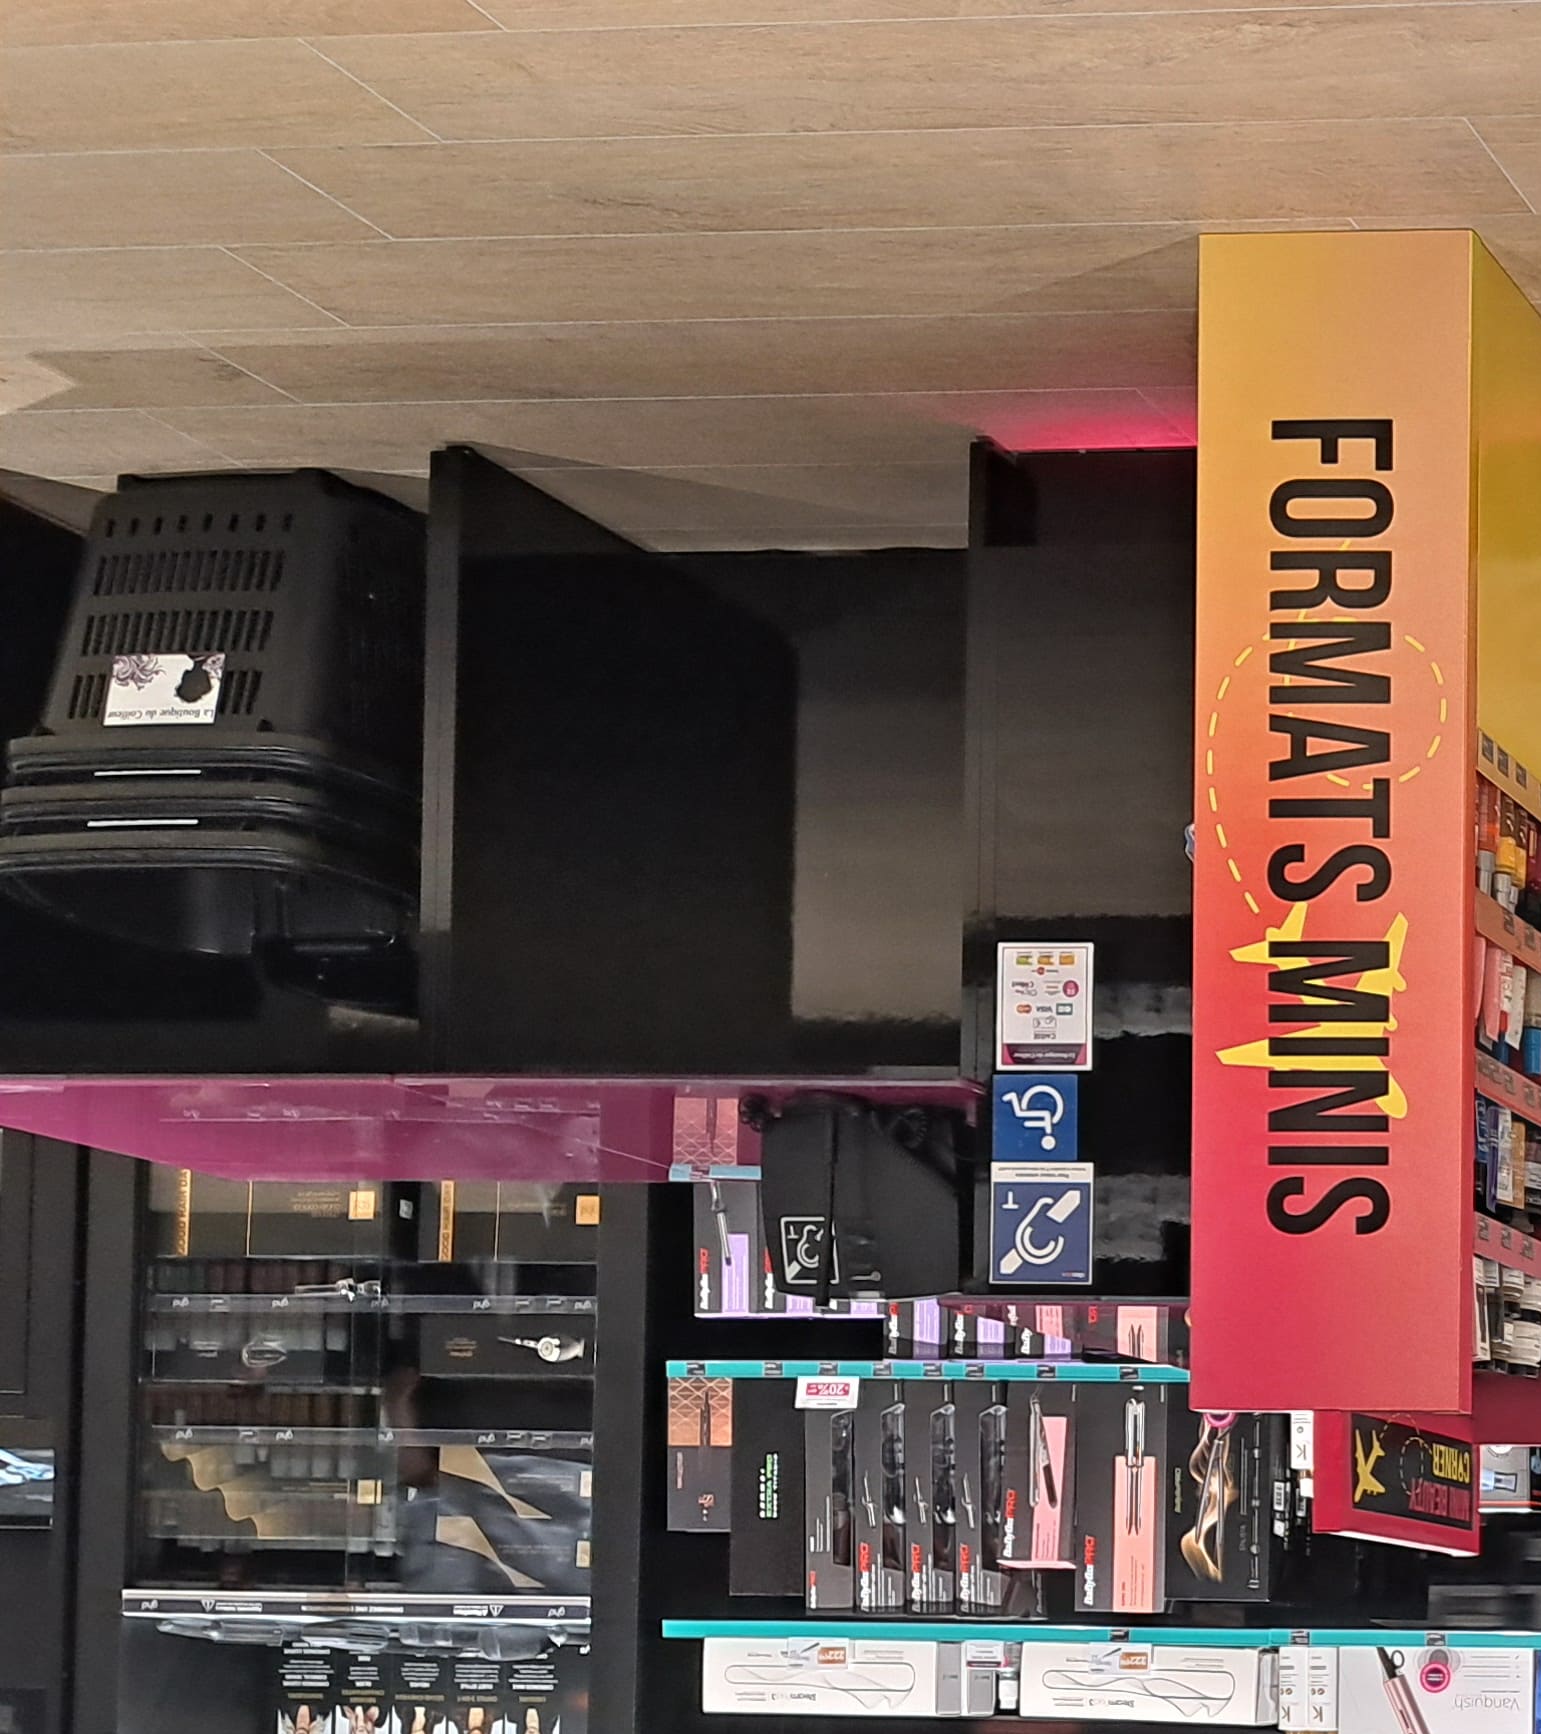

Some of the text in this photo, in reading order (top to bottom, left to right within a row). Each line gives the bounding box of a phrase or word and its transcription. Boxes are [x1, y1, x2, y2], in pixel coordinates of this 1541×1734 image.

[145, 710, 157, 719] du
[159, 708, 201, 719] Boutique
[204, 709, 214, 718] La
[1264, 417, 1395, 1238] FORMATS MINIS
[1001, 1191, 1019, 1209] T
[1453, 1694, 1520, 1711] Vanquish
